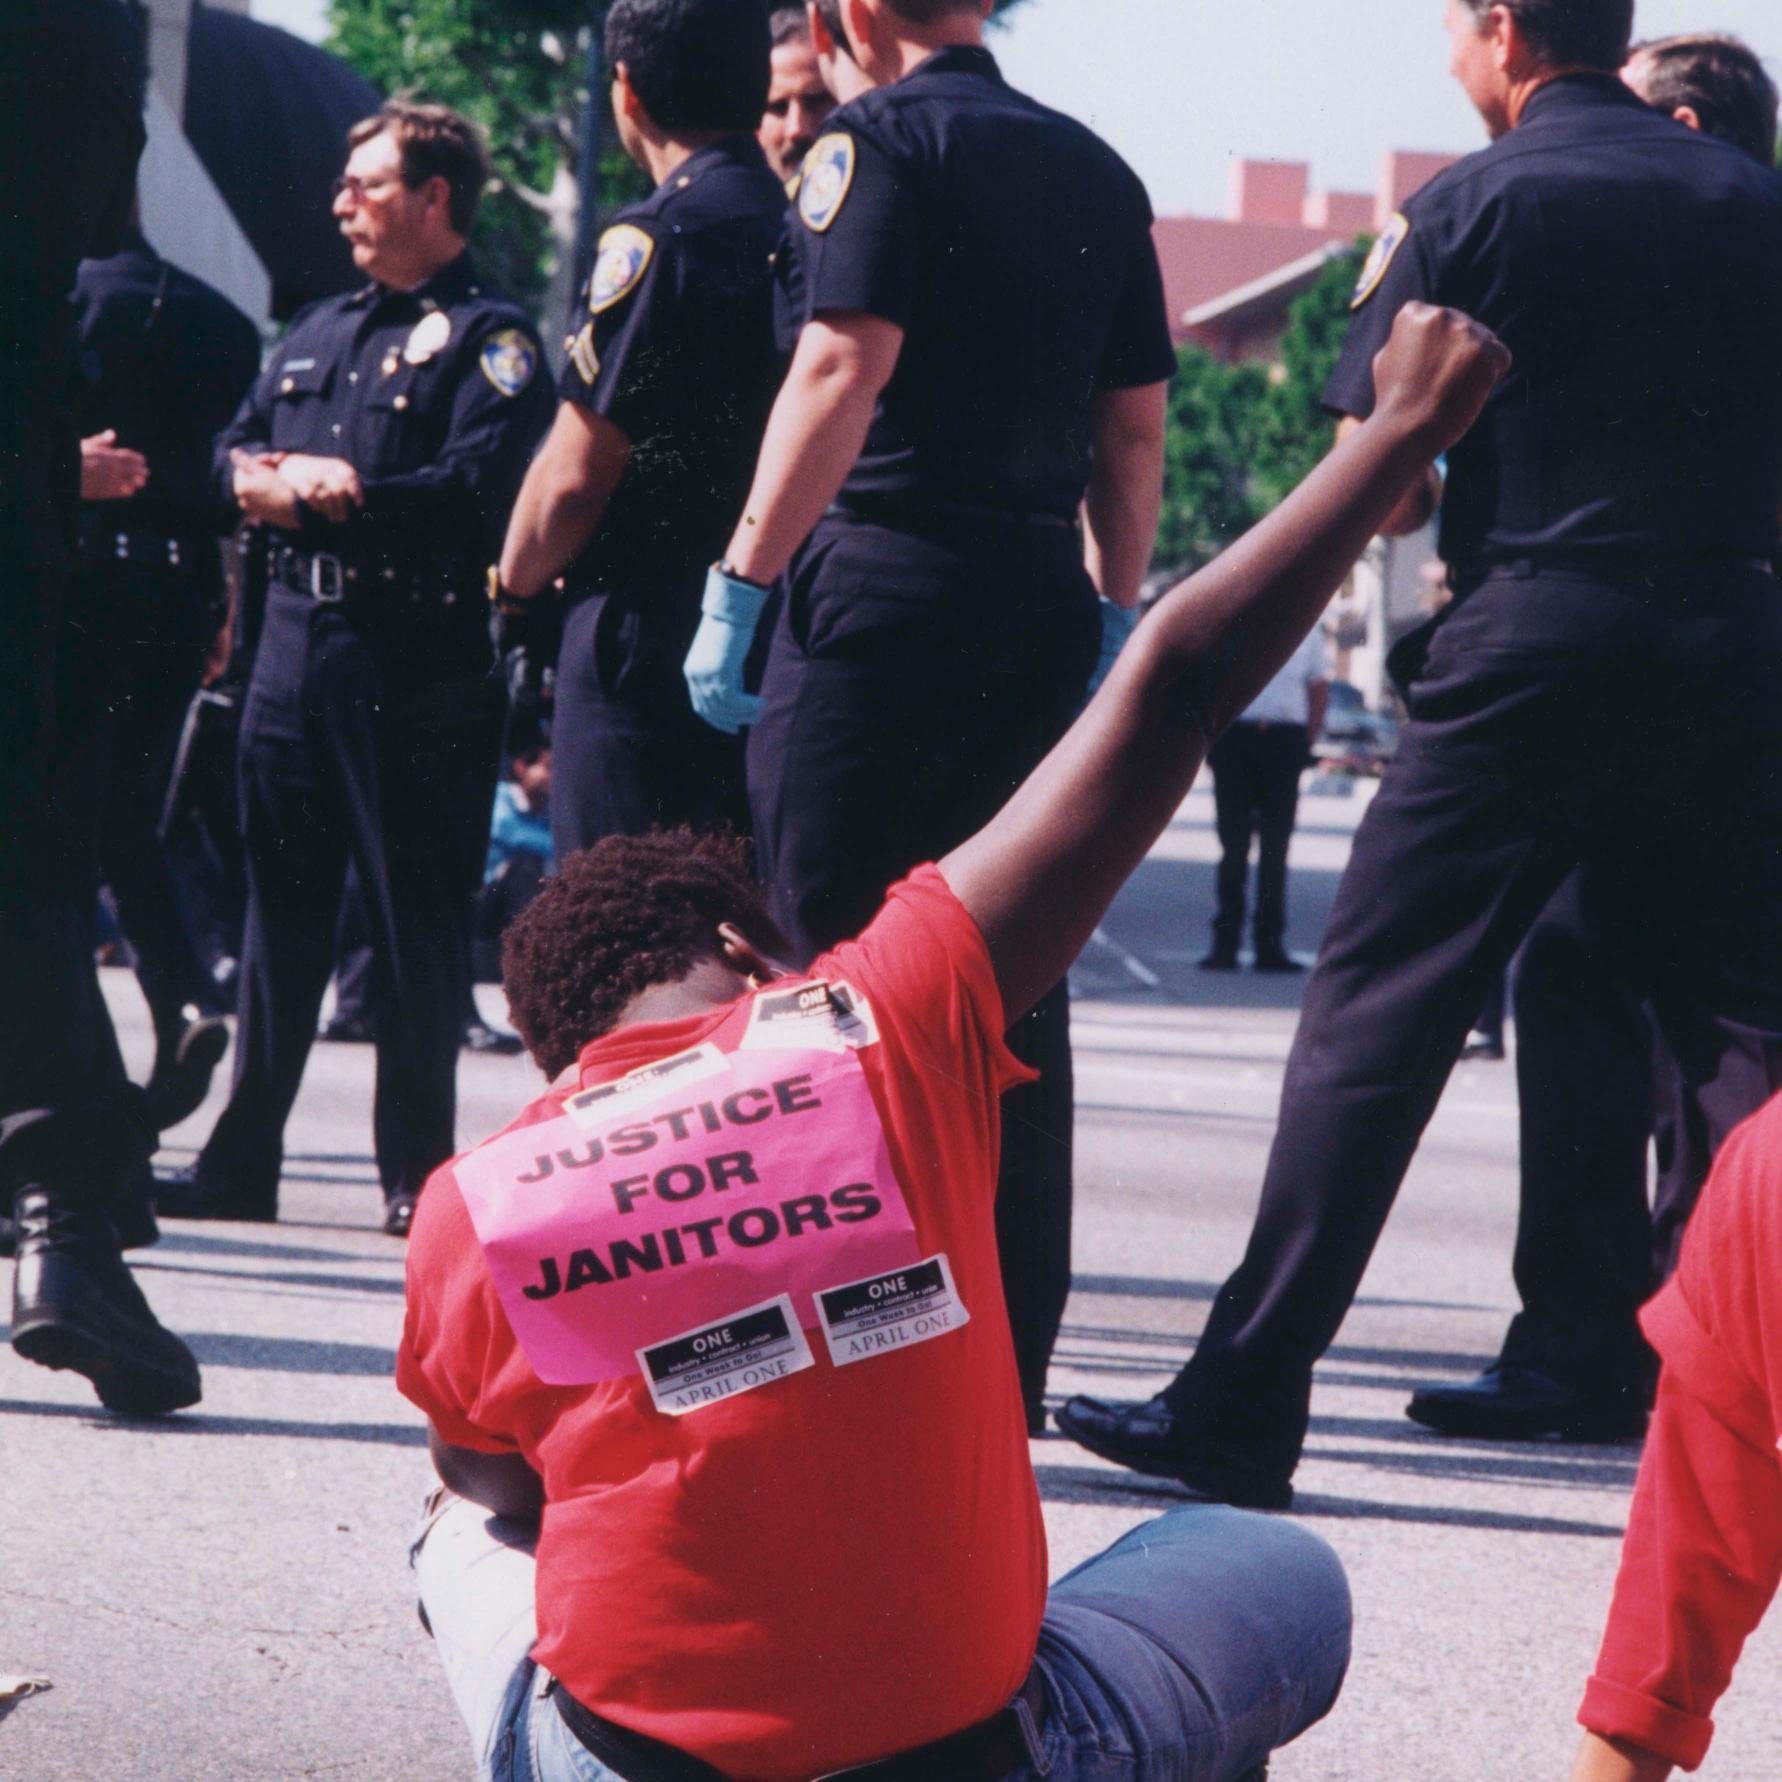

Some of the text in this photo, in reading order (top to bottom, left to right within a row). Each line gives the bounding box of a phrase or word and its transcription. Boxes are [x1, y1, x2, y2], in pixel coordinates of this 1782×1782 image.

[799, 986, 827, 1009] ONE
[516, 1074, 821, 1184] JUSTICE
[610, 1150, 758, 1213] FOR
[522, 1182, 881, 1300] JANITORS
[868, 1276, 907, 1298] ONE
[843, 1303, 875, 1318] industry
[883, 1292, 914, 1307] contract
[858, 1318, 876, 1328] One
[880, 1310, 904, 1321] Week
[693, 1328, 733, 1352] ONE
[849, 1311, 950, 1355] APRIL ONE
[668, 1332, 771, 1374] industry contract union
[675, 1359, 789, 1409] APRIL ONE
[683, 1371, 703, 1383] One
[705, 1362, 732, 1376] Week
[733, 1358, 744, 1366] to
